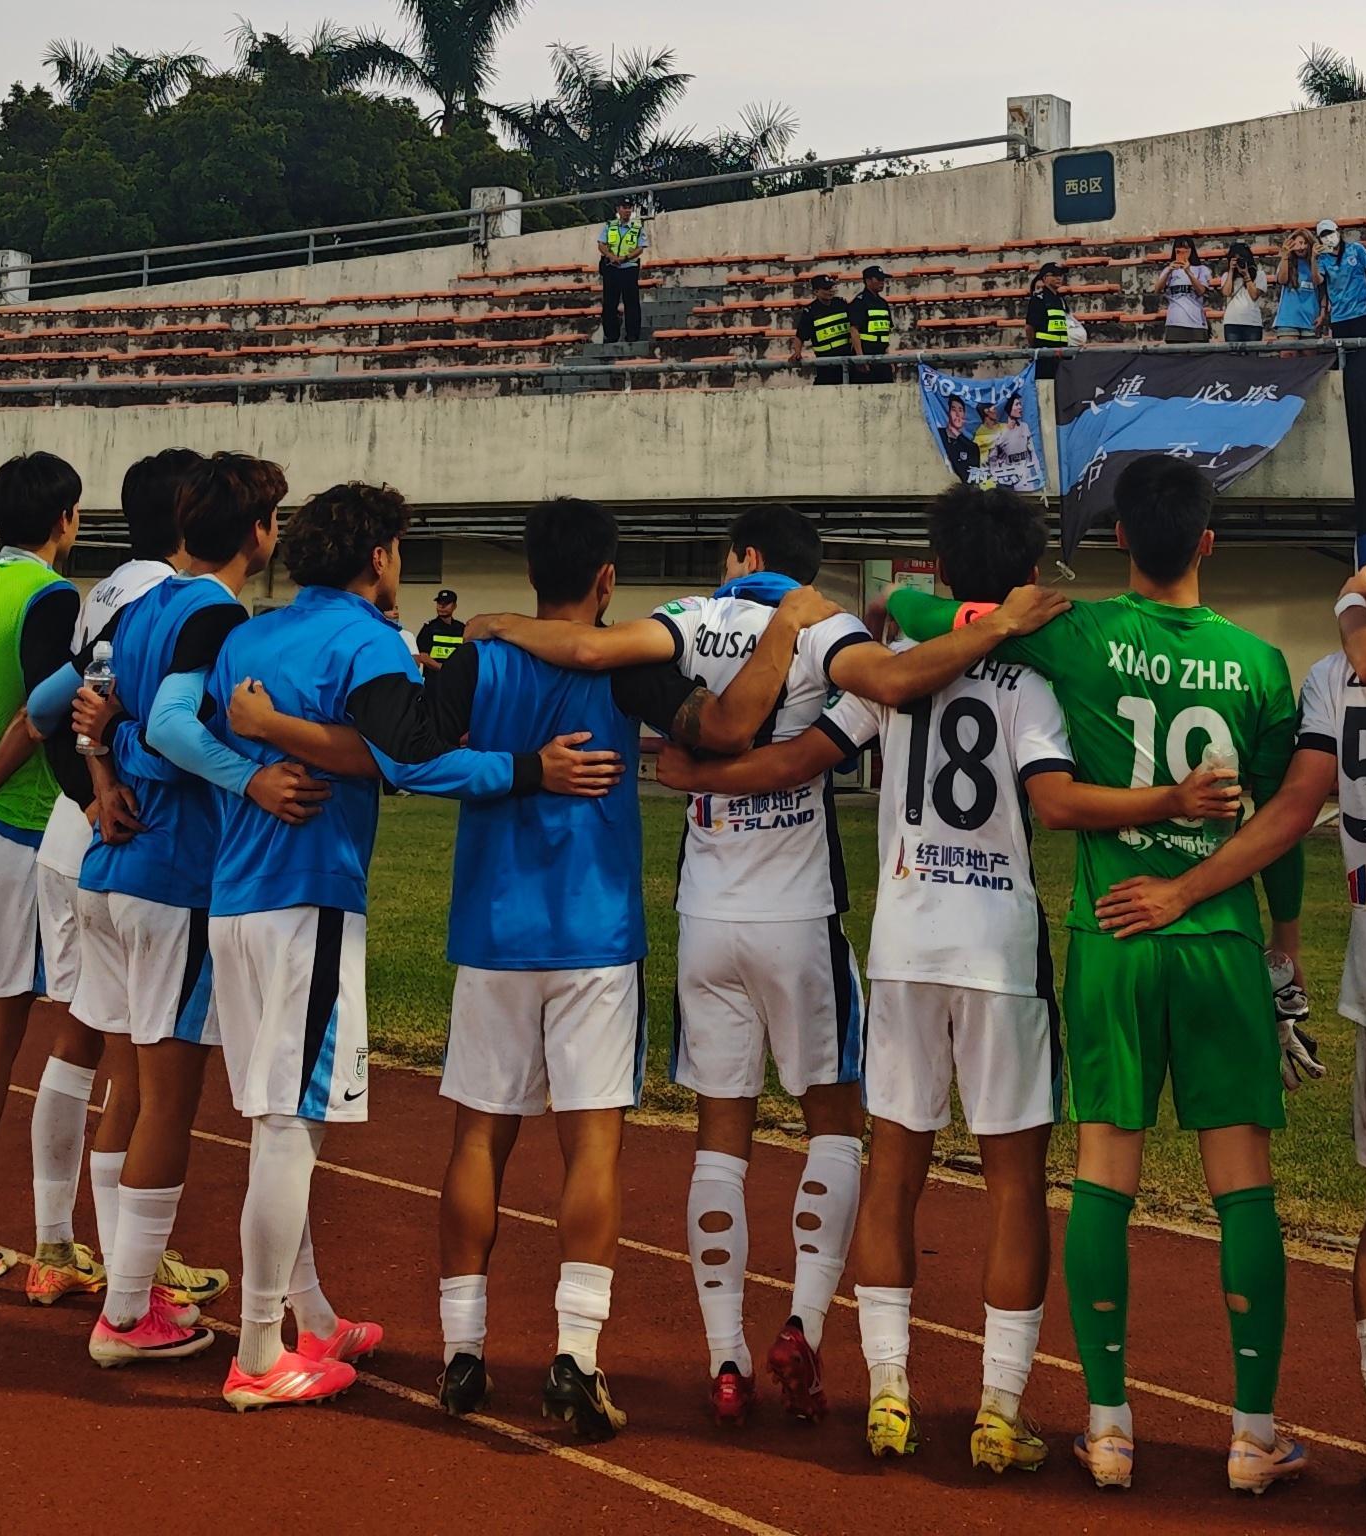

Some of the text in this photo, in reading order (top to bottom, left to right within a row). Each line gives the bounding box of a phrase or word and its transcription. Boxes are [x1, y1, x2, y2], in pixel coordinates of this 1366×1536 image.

[1064, 176, 1103, 196] 西8区
[1107, 640, 1250, 692] XIAO ZH.R.
[896, 696, 999, 831] 18
[728, 785, 813, 818] 统顺地产
[728, 807, 815, 832] TSLAND
[915, 842, 1010, 873] 统顺地产
[915, 867, 1014, 892] TSLAND
